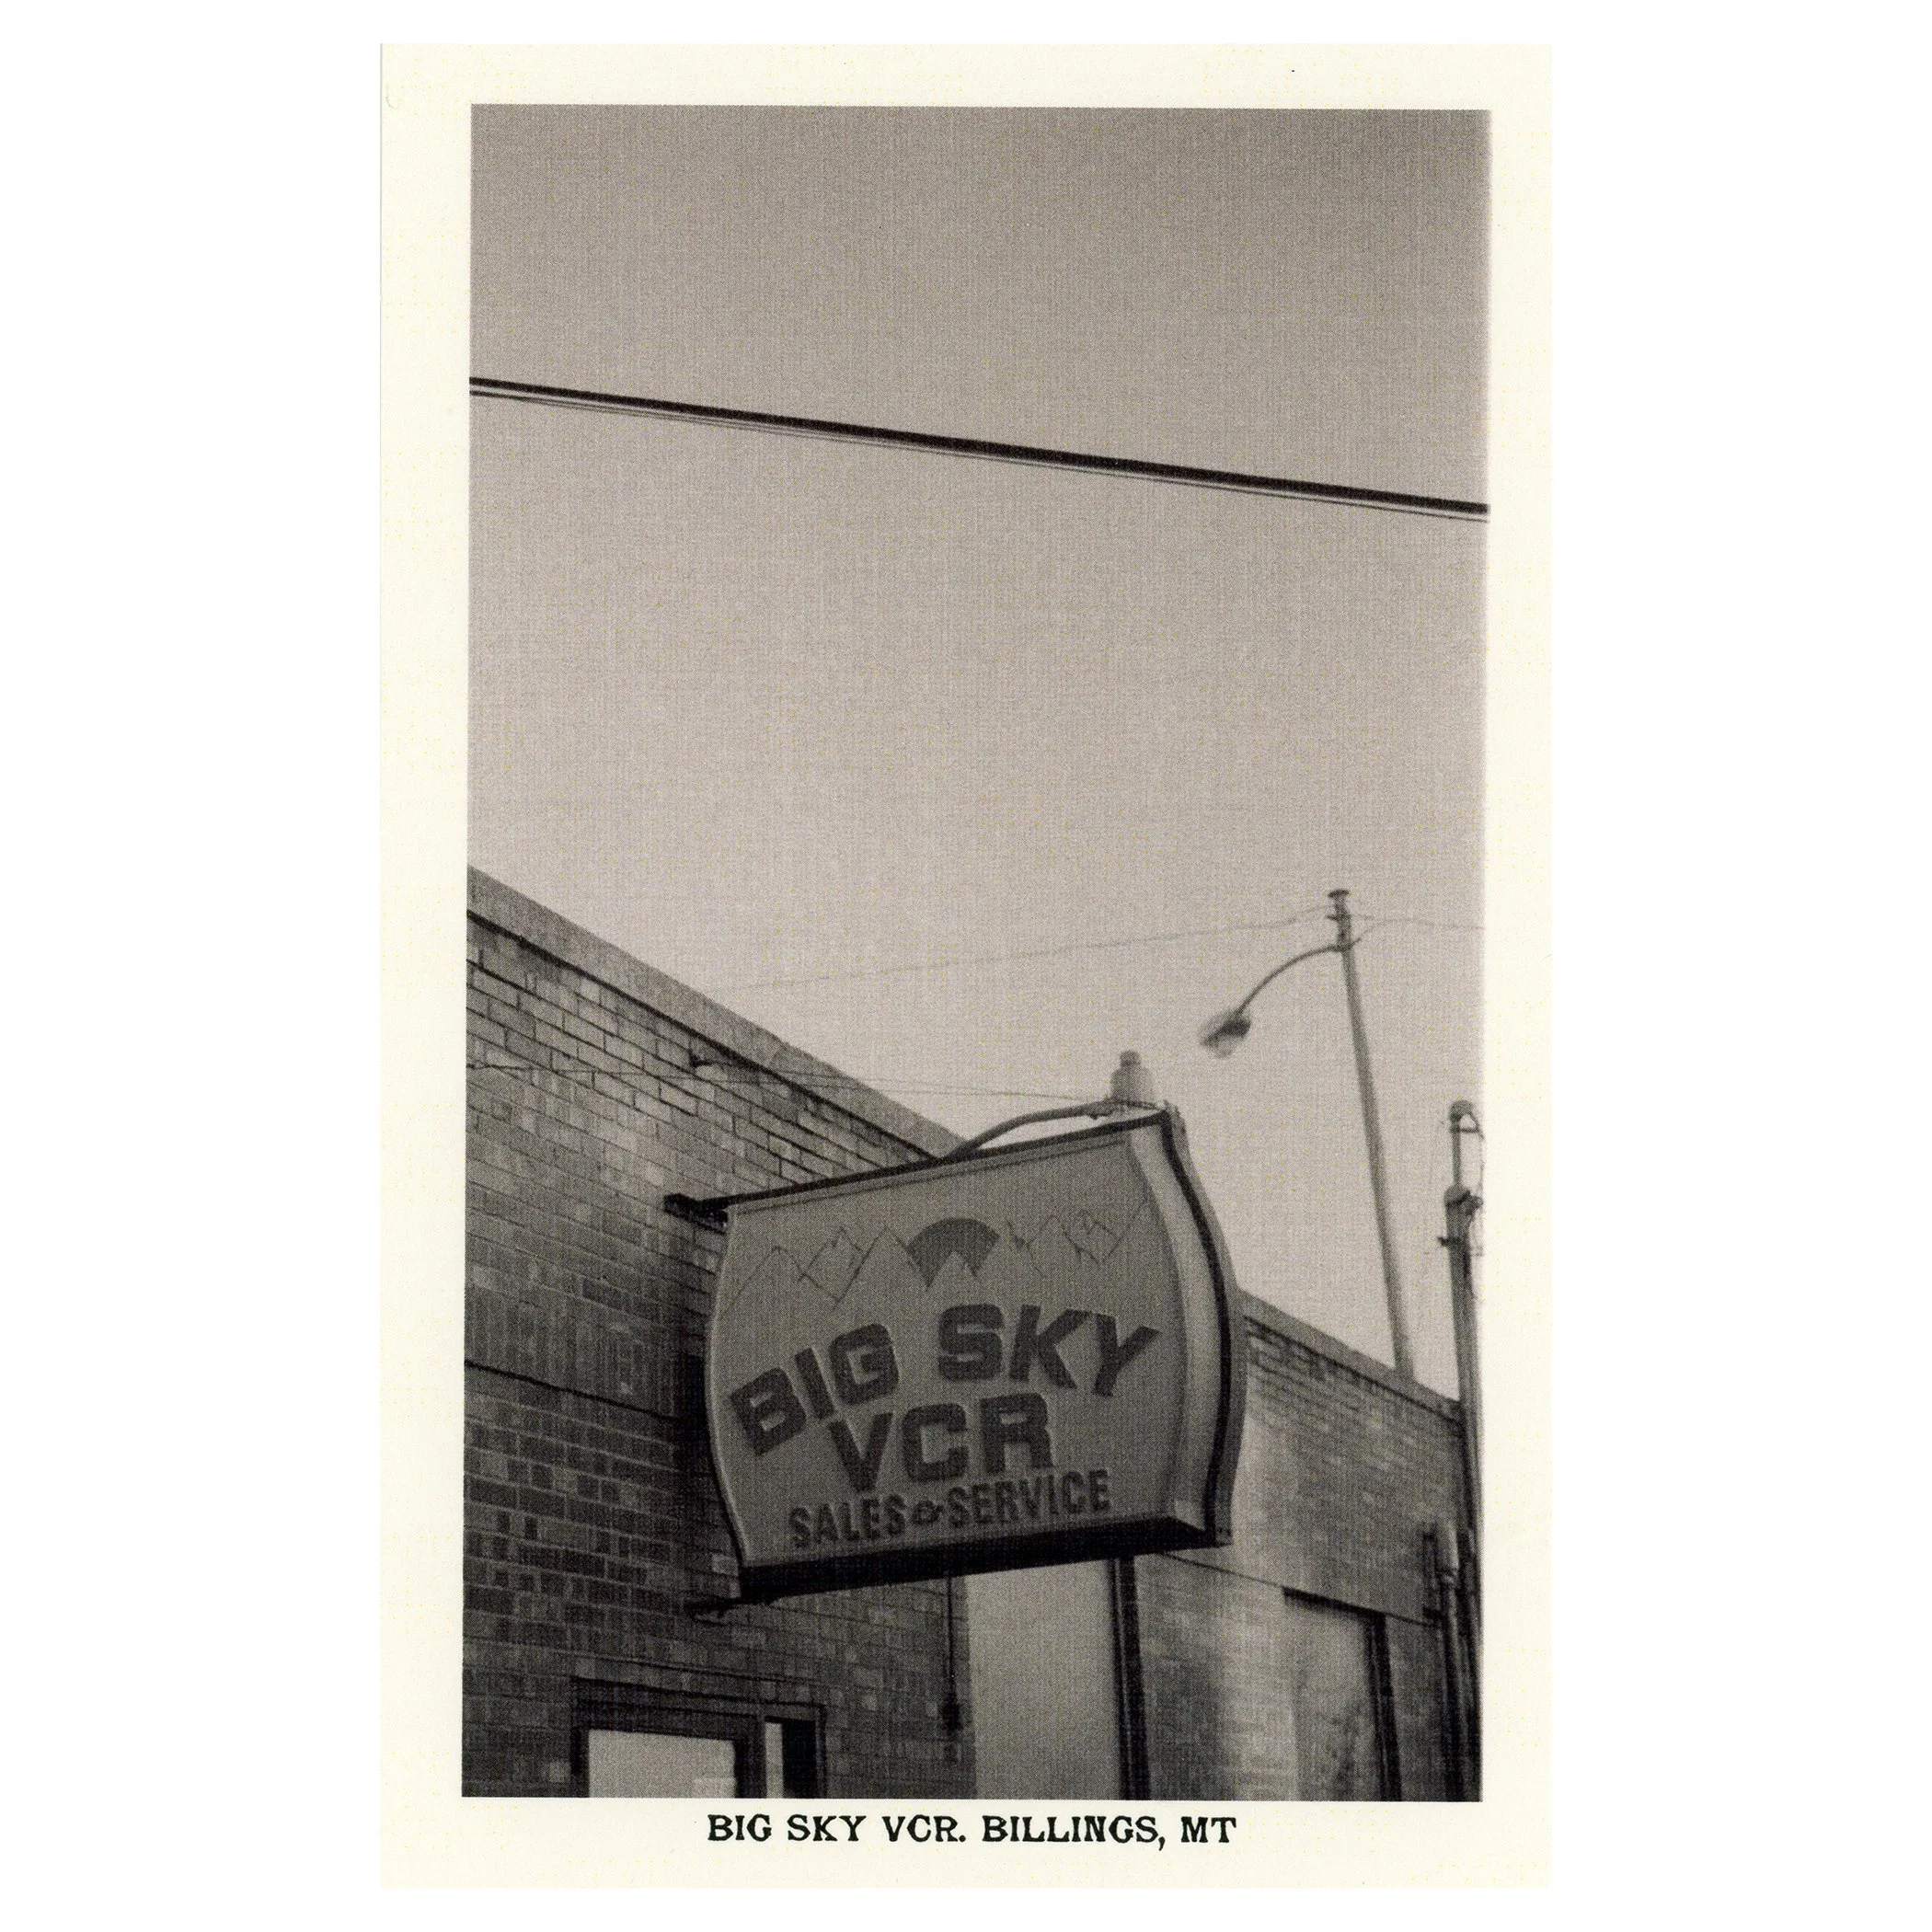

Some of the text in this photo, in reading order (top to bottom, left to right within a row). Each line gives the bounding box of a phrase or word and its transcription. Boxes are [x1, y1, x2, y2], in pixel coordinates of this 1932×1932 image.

[730, 1303, 1164, 1456] BIG SKY
[829, 1392, 1053, 1491] VCR
[788, 1493, 907, 1547] SALES
[945, 1469, 1111, 1530] SERVICE
